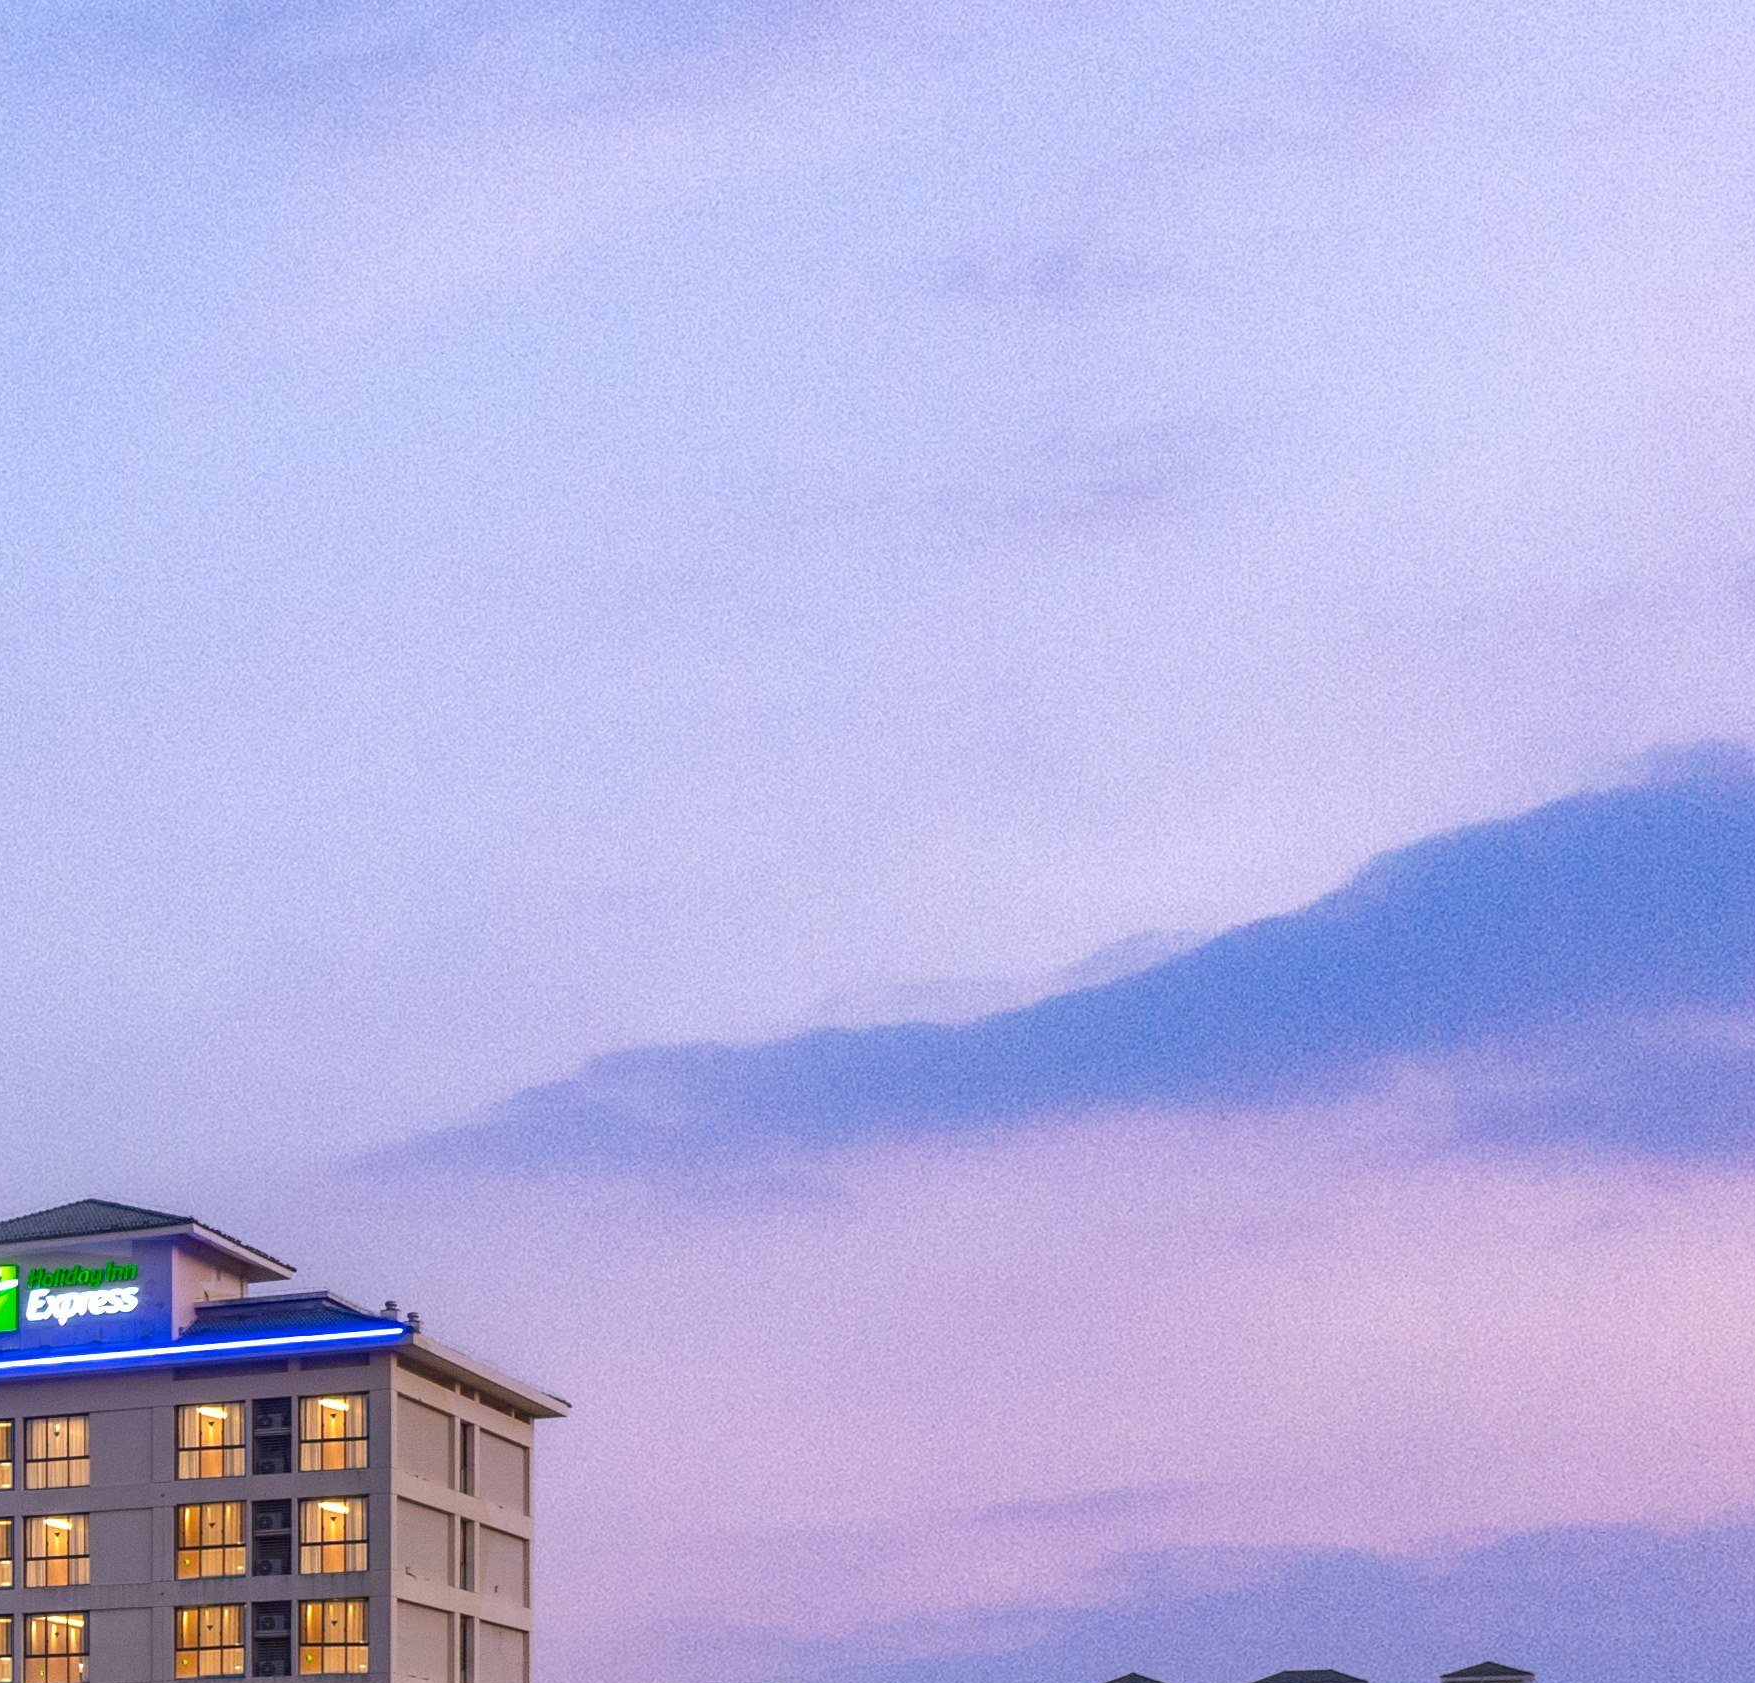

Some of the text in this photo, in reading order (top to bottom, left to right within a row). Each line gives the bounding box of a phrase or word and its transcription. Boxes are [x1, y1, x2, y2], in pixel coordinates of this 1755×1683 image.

[27, 1259, 138, 1289] Holiday Inn
[25, 1286, 140, 1326] Express
